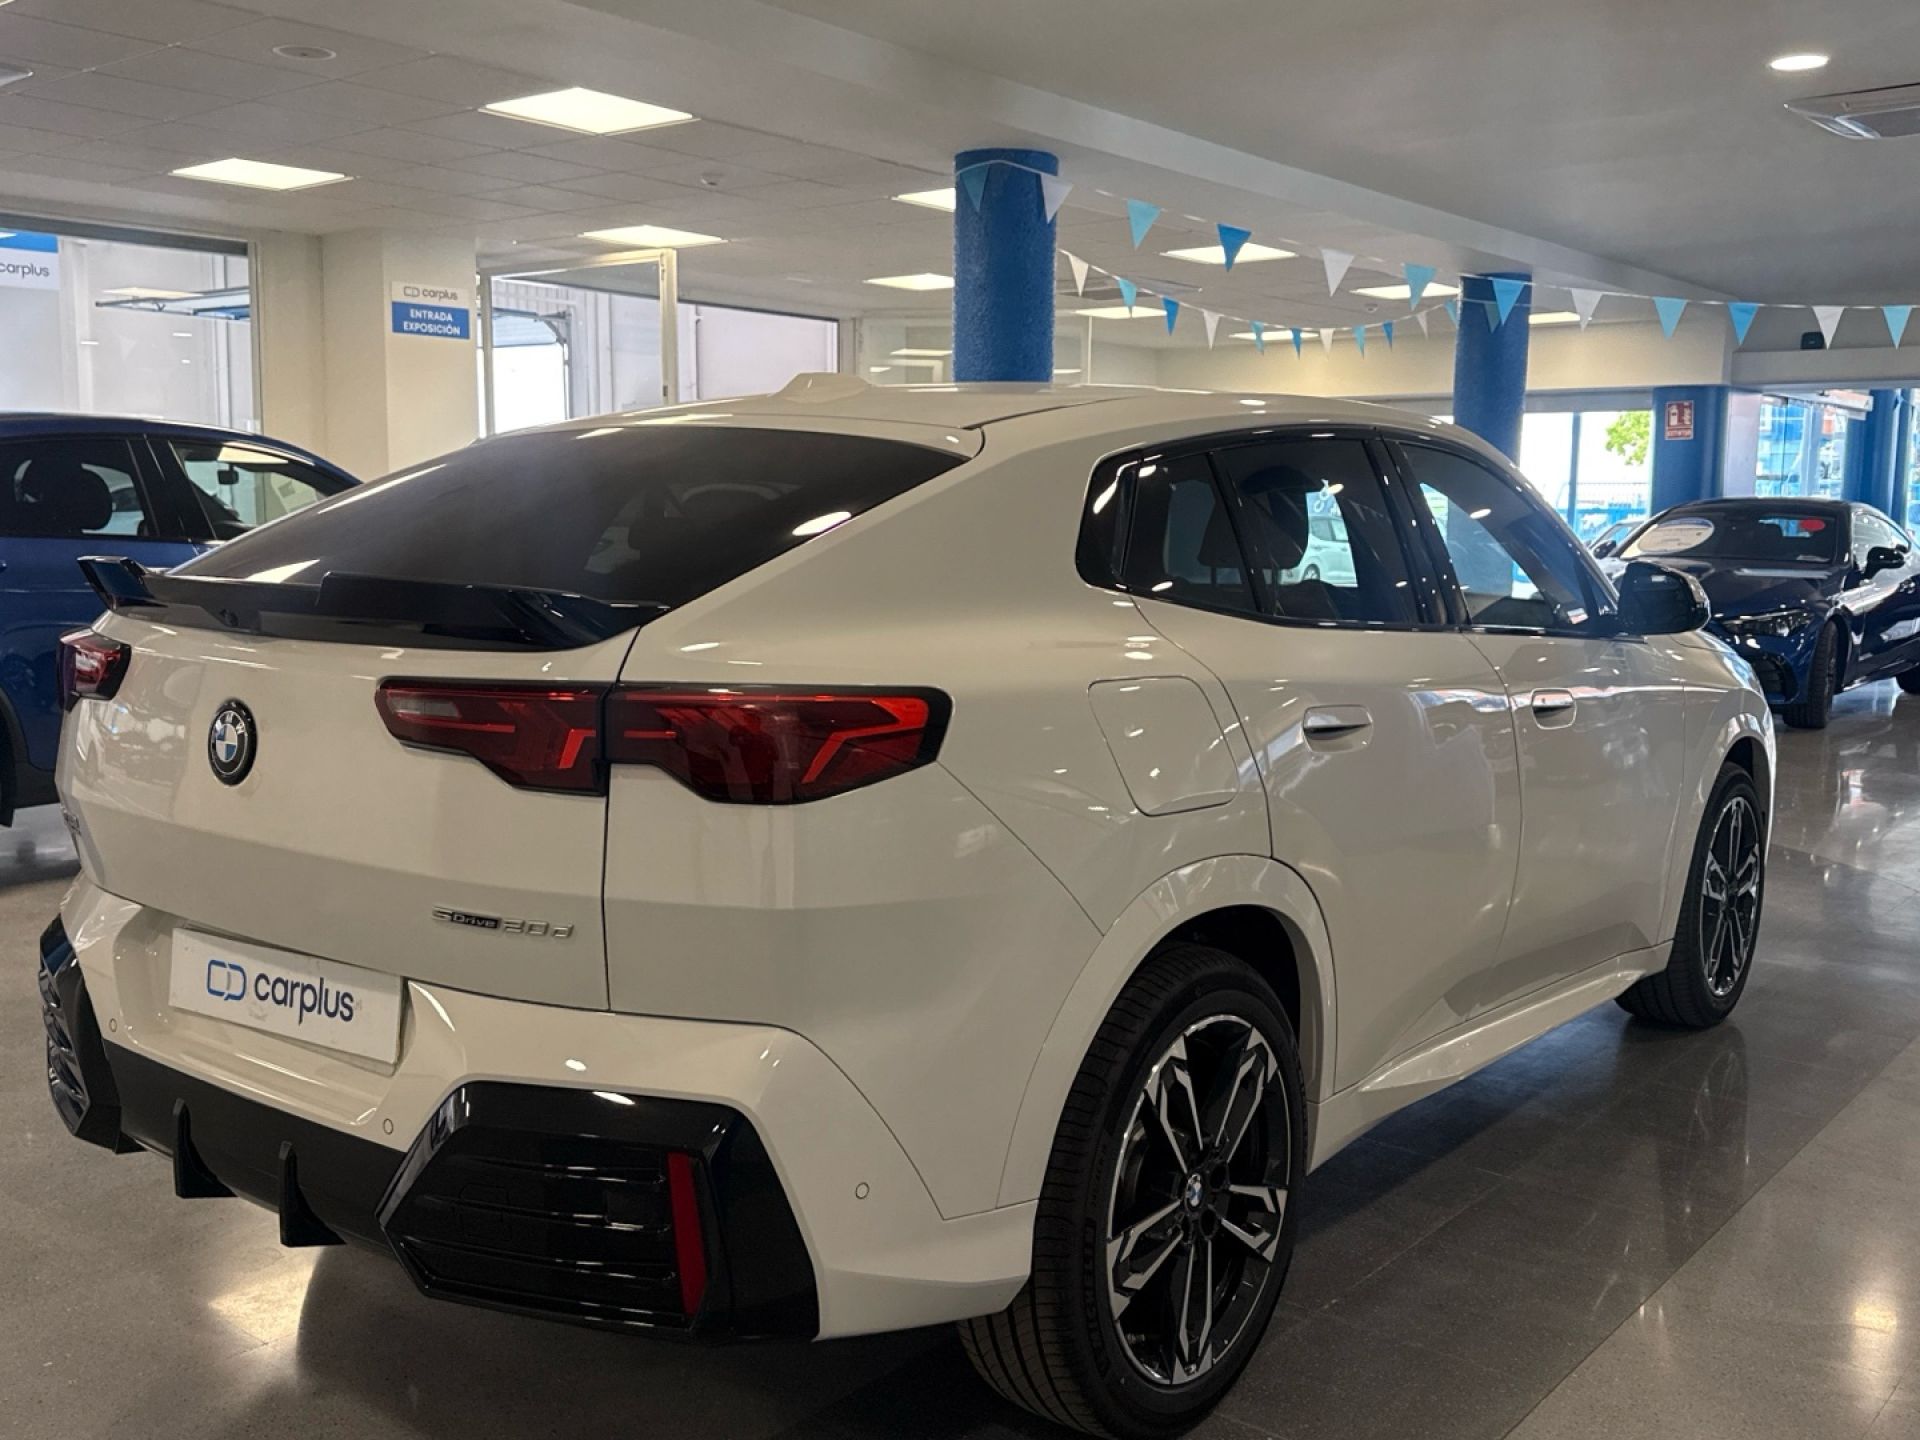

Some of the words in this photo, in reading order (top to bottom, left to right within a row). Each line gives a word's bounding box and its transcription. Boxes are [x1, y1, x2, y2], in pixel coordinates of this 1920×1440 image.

[422, 288, 458, 302] carplus
[410, 308, 453, 322] ENTRADA
[403, 321, 461, 336] EXPOSICIÓN
[254, 972, 354, 1025] carplus
